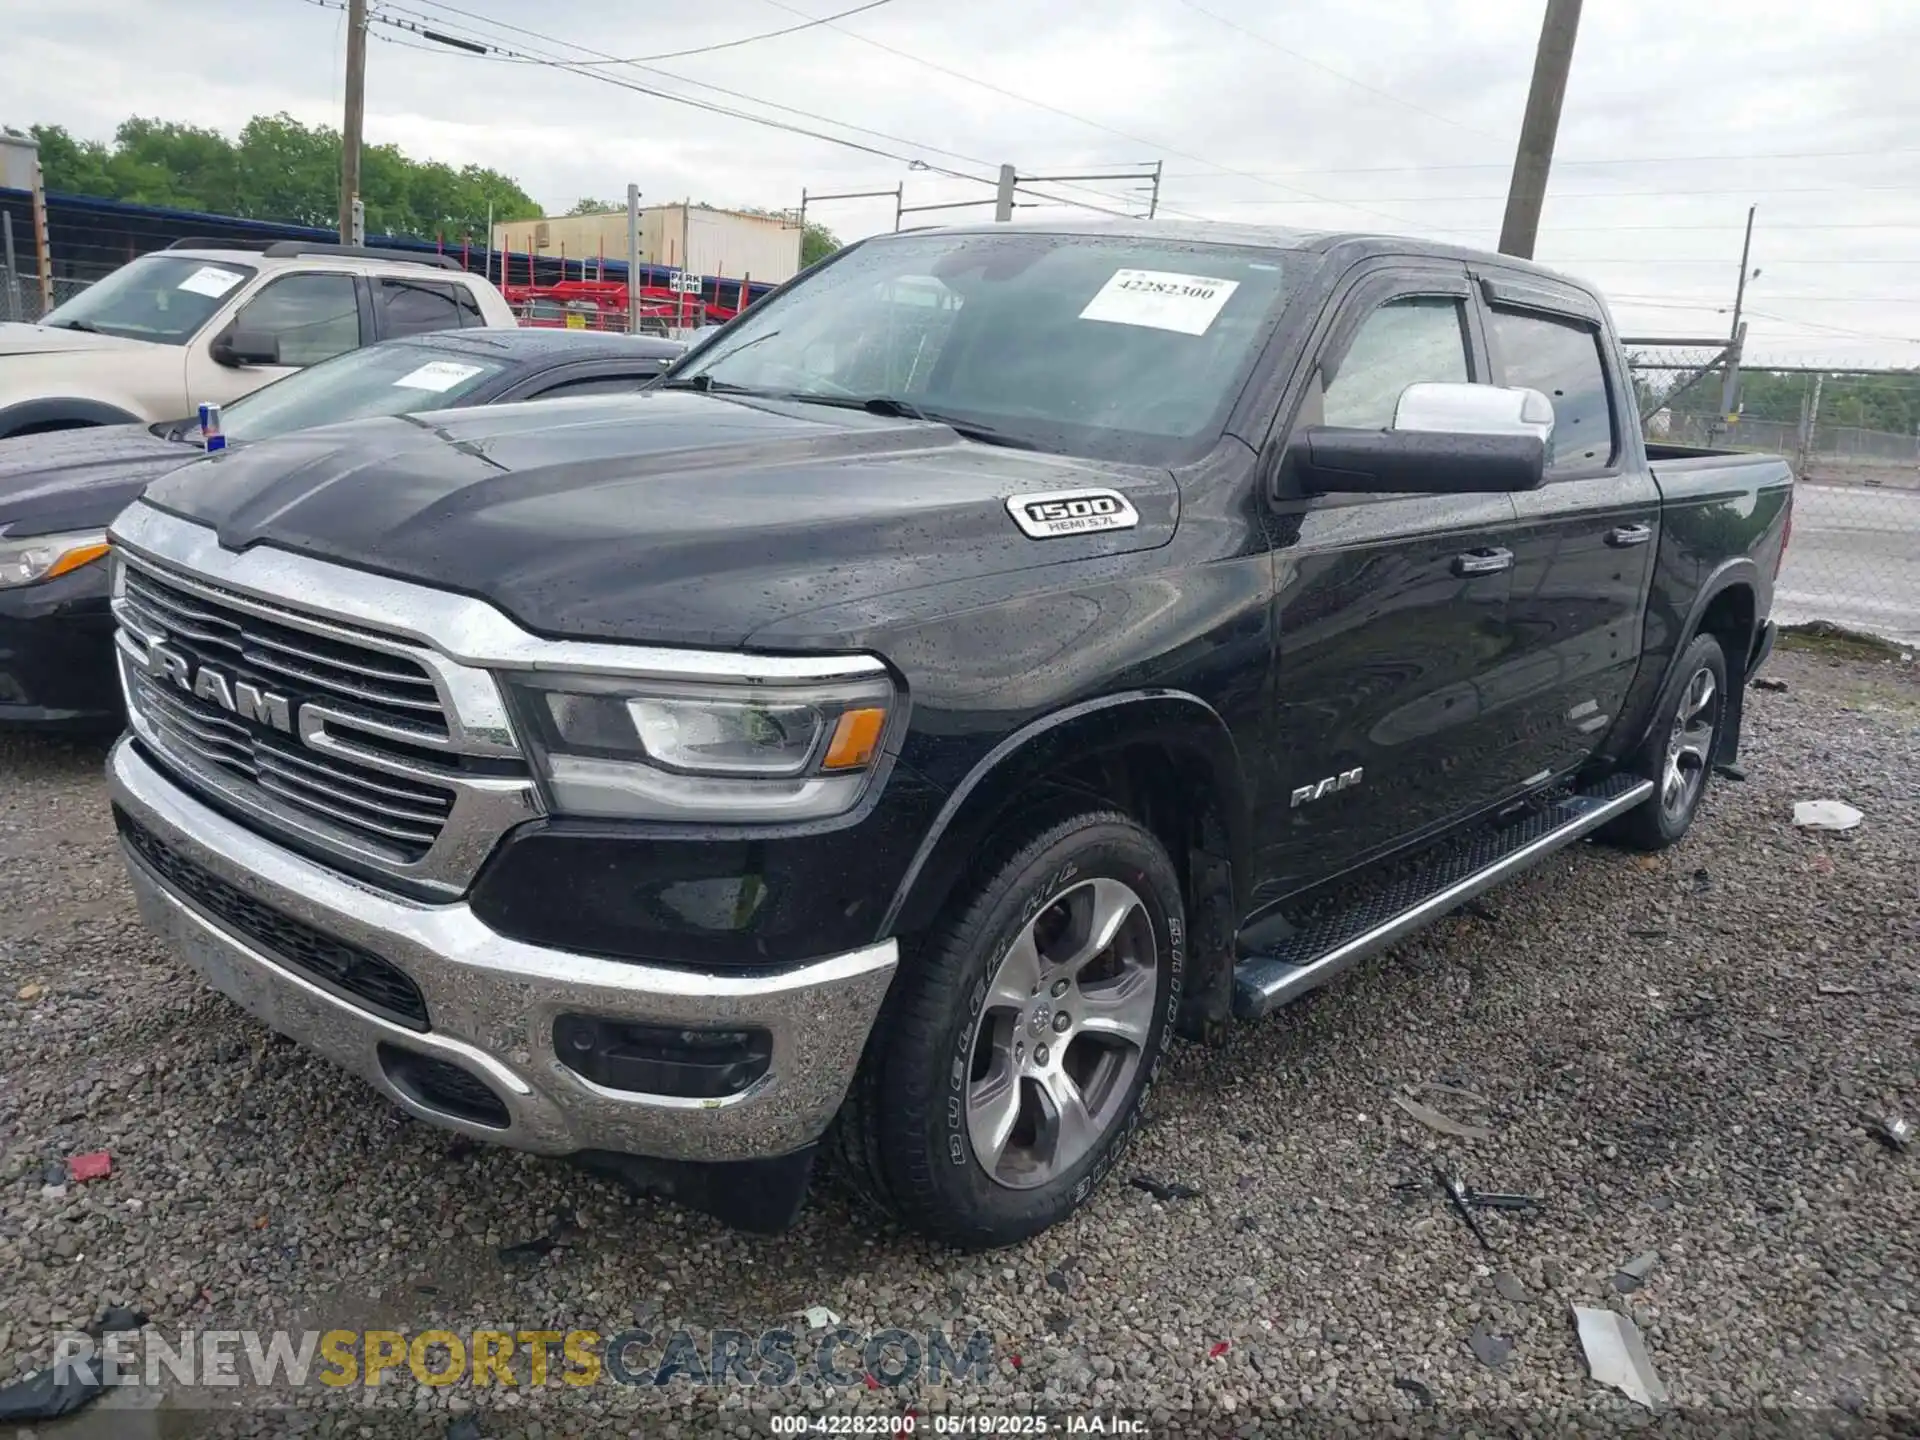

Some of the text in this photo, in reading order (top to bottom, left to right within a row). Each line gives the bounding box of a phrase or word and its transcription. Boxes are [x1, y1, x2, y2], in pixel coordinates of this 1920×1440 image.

[671, 282, 700, 292] HRE
[1117, 278, 1215, 301] 42282300
[1028, 498, 1116, 520] 1500
[1049, 515, 1119, 533] HEMI 5.7L
[149, 642, 292, 734] RAM
[1290, 766, 1363, 808] RAM
